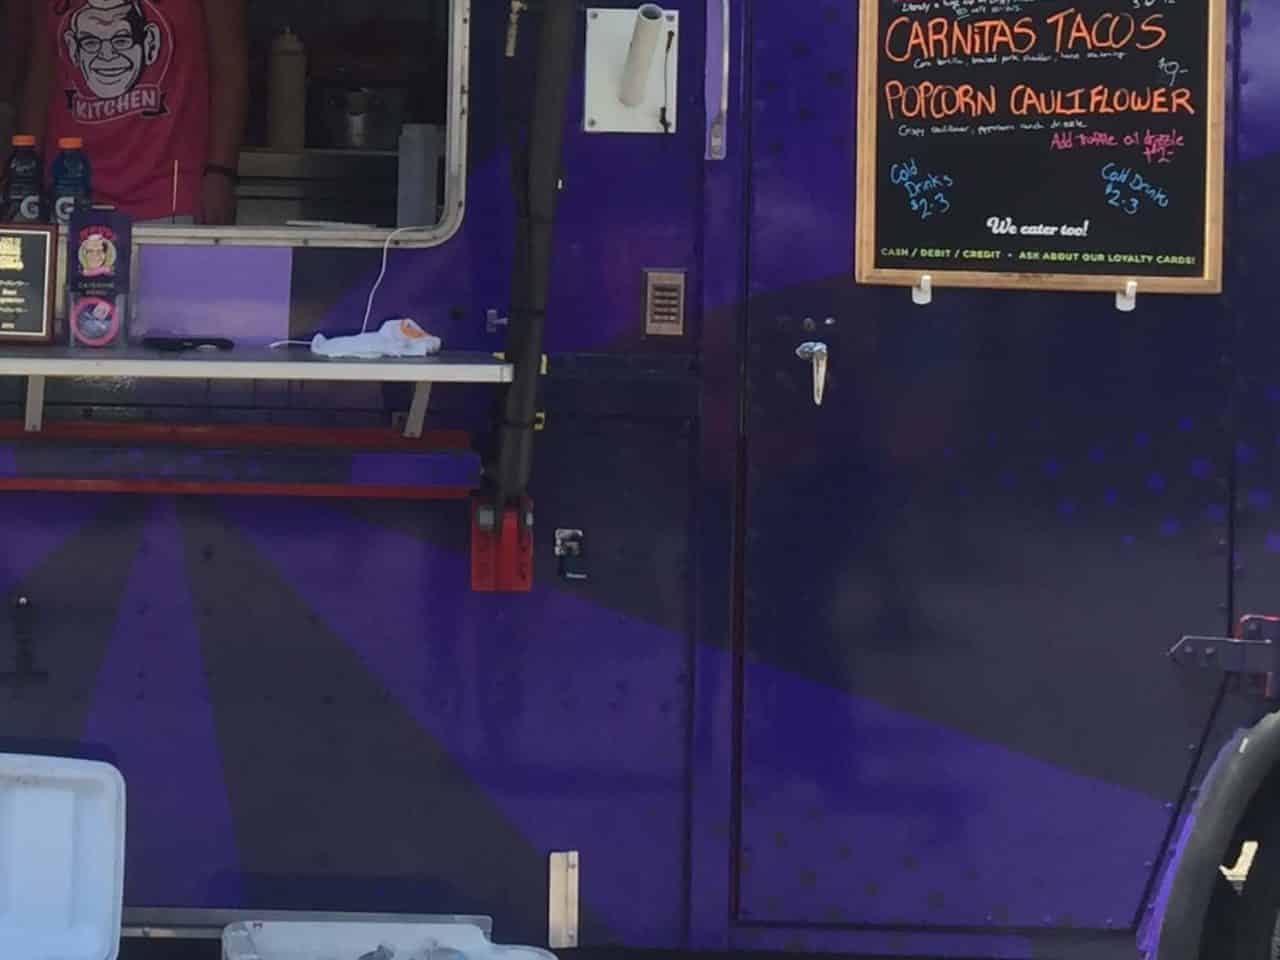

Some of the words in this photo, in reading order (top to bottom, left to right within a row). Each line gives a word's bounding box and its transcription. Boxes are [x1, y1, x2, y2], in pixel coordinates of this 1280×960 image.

[1046, 8, 1168, 53] TACOS
[76, 90, 156, 119] KITCHEN
[885, 80, 997, 120] POPCORN
[1010, 84, 1195, 116] CAULIFLOWER
[21, 195, 39, 219] G
[56, 196, 74, 220] G
[986, 217, 1017, 234] We
[1020, 223, 1058, 235] cater
[1061, 219, 1089, 237] too!
[881, 247, 909, 256] CASH
[920, 248, 951, 257] DEBIT
[963, 249, 1001, 259] CREDIT
[1019, 251, 1040, 260] ASK
[1042, 252, 1080, 261] ABOUT
[1083, 253, 1105, 262] OUR
[1108, 253, 1153, 263] LOYALTY
[1156, 255, 1196, 265] CARDS!
